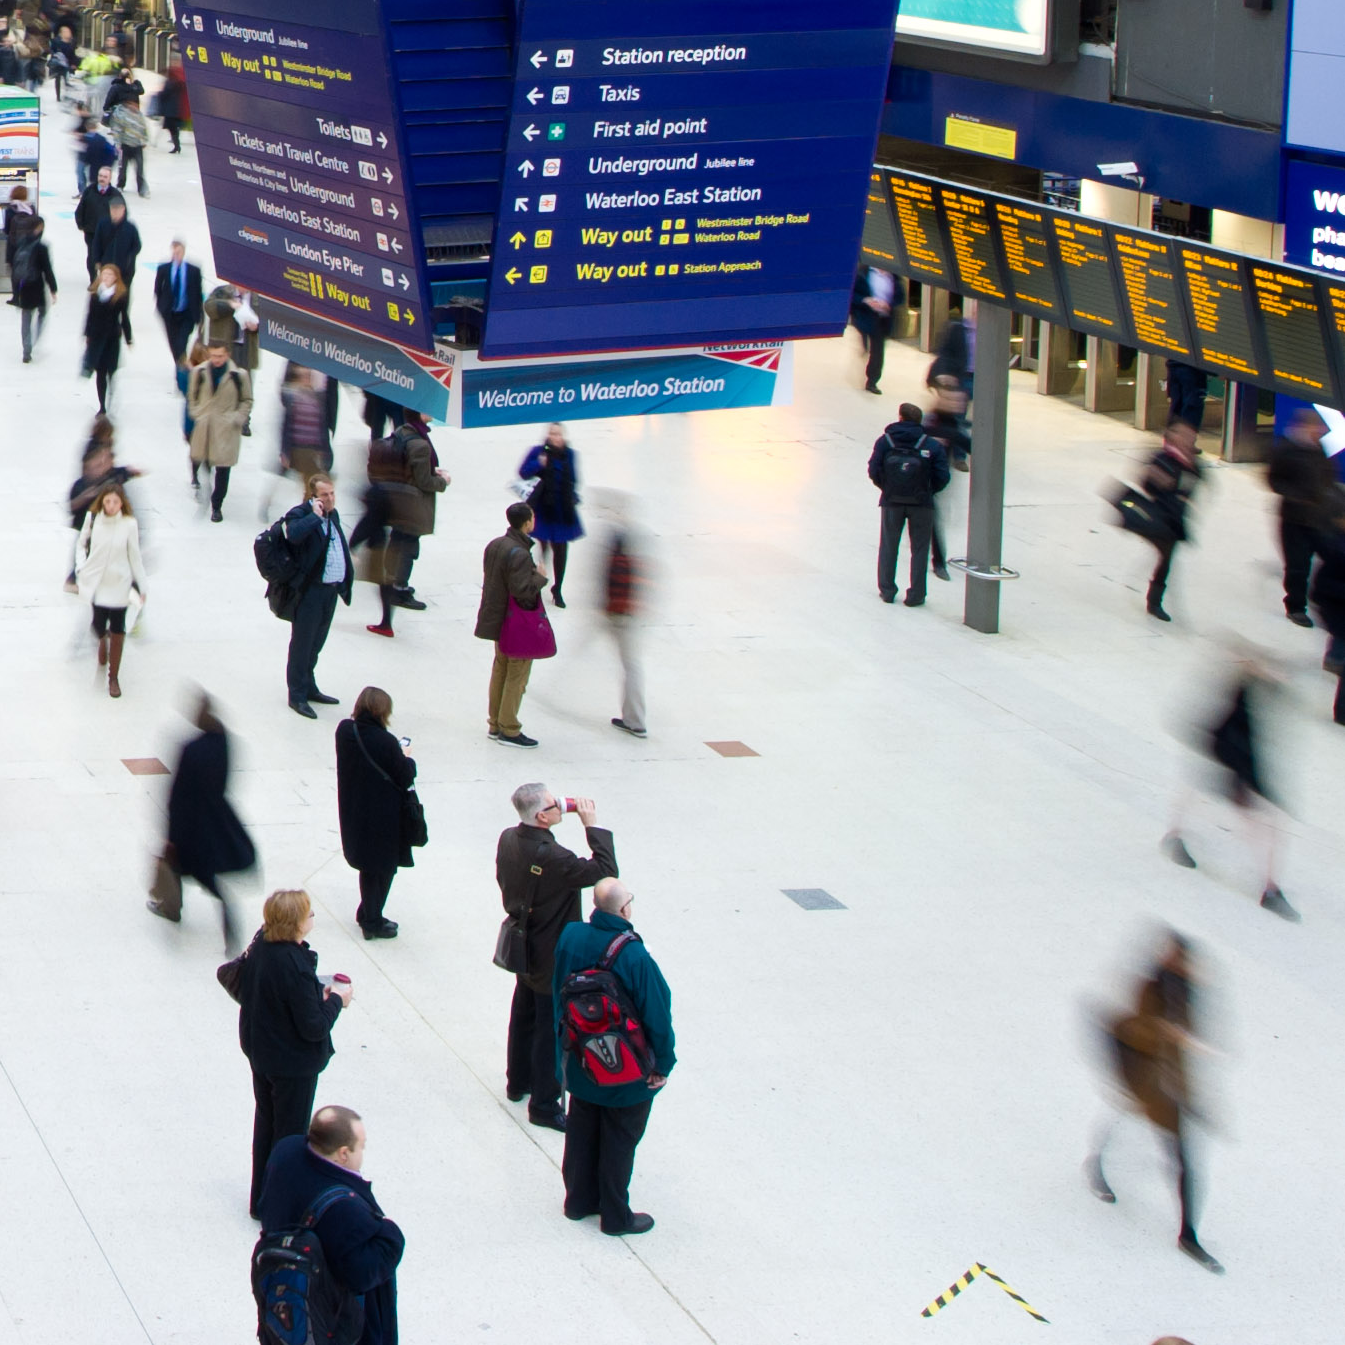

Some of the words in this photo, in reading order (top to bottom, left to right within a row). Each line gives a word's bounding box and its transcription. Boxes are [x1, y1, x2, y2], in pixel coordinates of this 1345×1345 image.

[216, 19, 275, 44] Underground
[221, 52, 241, 73] Way
[244, 58, 260, 73] out
[602, 48, 663, 66] Station
[667, 45, 746, 66] reception
[599, 84, 640, 102] Taxis
[316, 117, 352, 140] Toilets
[593, 120, 631, 138] First
[634, 119, 660, 136] aid
[663, 118, 707, 139] point
[231, 130, 265, 152] Tickets
[266, 141, 283, 157] and
[283, 143, 313, 165] Travel
[315, 153, 349, 174] Centre
[588, 153, 698, 176] Underground
[703, 157, 736, 169] Jubilee
[737, 156, 754, 167] line
[289, 176, 355, 208] Underground
[585, 191, 659, 209] Waterloo
[664, 188, 699, 206] East
[702, 186, 762, 204] Station
[257, 198, 299, 224] Waterloo
[300, 210, 322, 231] East
[324, 218, 360, 243] Station
[697, 217, 753, 228] Westminster
[754, 215, 784, 227] Bridge
[786, 213, 810, 224] Road
[581, 228, 618, 248] Way
[622, 226, 653, 243] out
[694, 232, 735, 243] Waterloo
[737, 230, 761, 241] Road
[284, 238, 321, 263] London
[322, 250, 341, 271] Eye
[343, 256, 364, 277] Pier
[684, 263, 716, 274] Station
[718, 260, 762, 273] Approach
[576, 264, 612, 283] Way
[617, 262, 648, 278] out
[326, 282, 351, 307] Way
[352, 293, 371, 311] out
[267, 319, 310, 349] Welcome
[312, 338, 322, 354] to
[324, 341, 372, 374] Waterloo
[375, 361, 414, 391] Station
[478, 388, 554, 409] Welcome
[557, 386, 575, 403] to
[580, 379, 659, 402] Waterloo
[662, 375, 725, 396] Station
